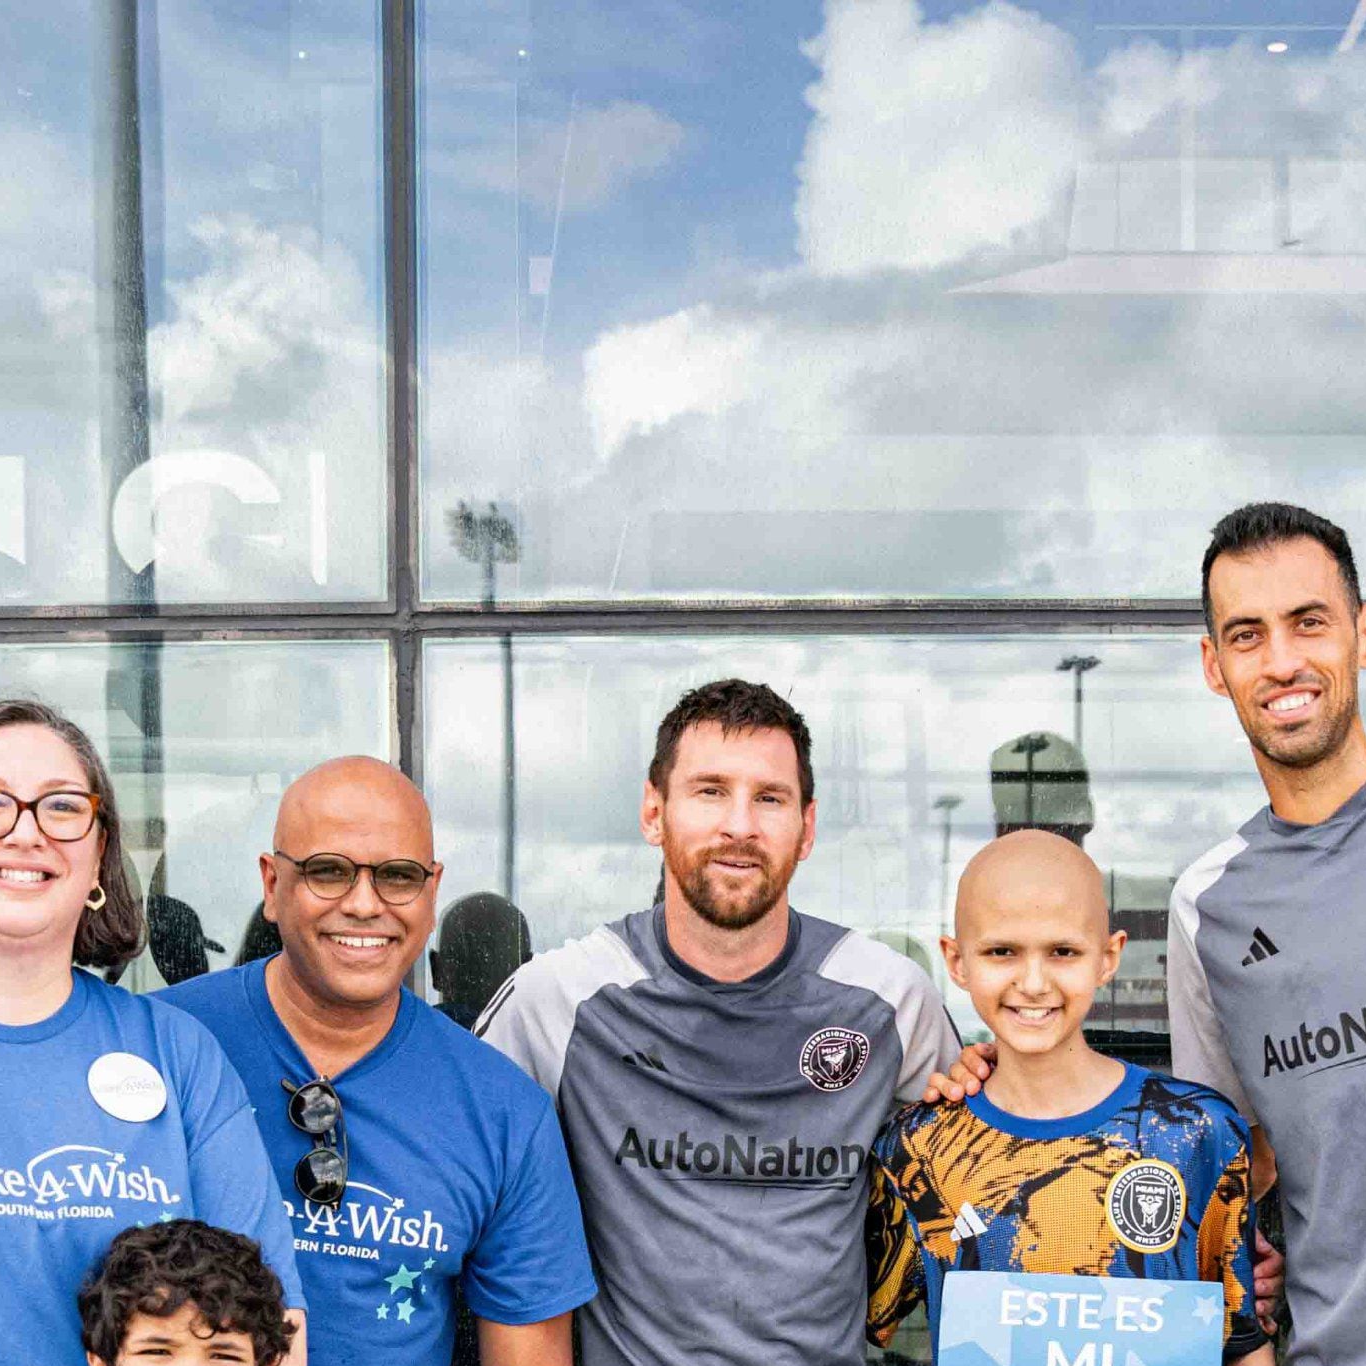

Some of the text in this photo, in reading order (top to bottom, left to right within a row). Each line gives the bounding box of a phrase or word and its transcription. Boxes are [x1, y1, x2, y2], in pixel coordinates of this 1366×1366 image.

[614, 1126, 866, 1178] AutoNation
[1135, 1184, 1166, 1195] MIAMI
[322, 1242, 380, 1261] FLORIDA
[999, 1289, 1165, 1333] ESTE ES
